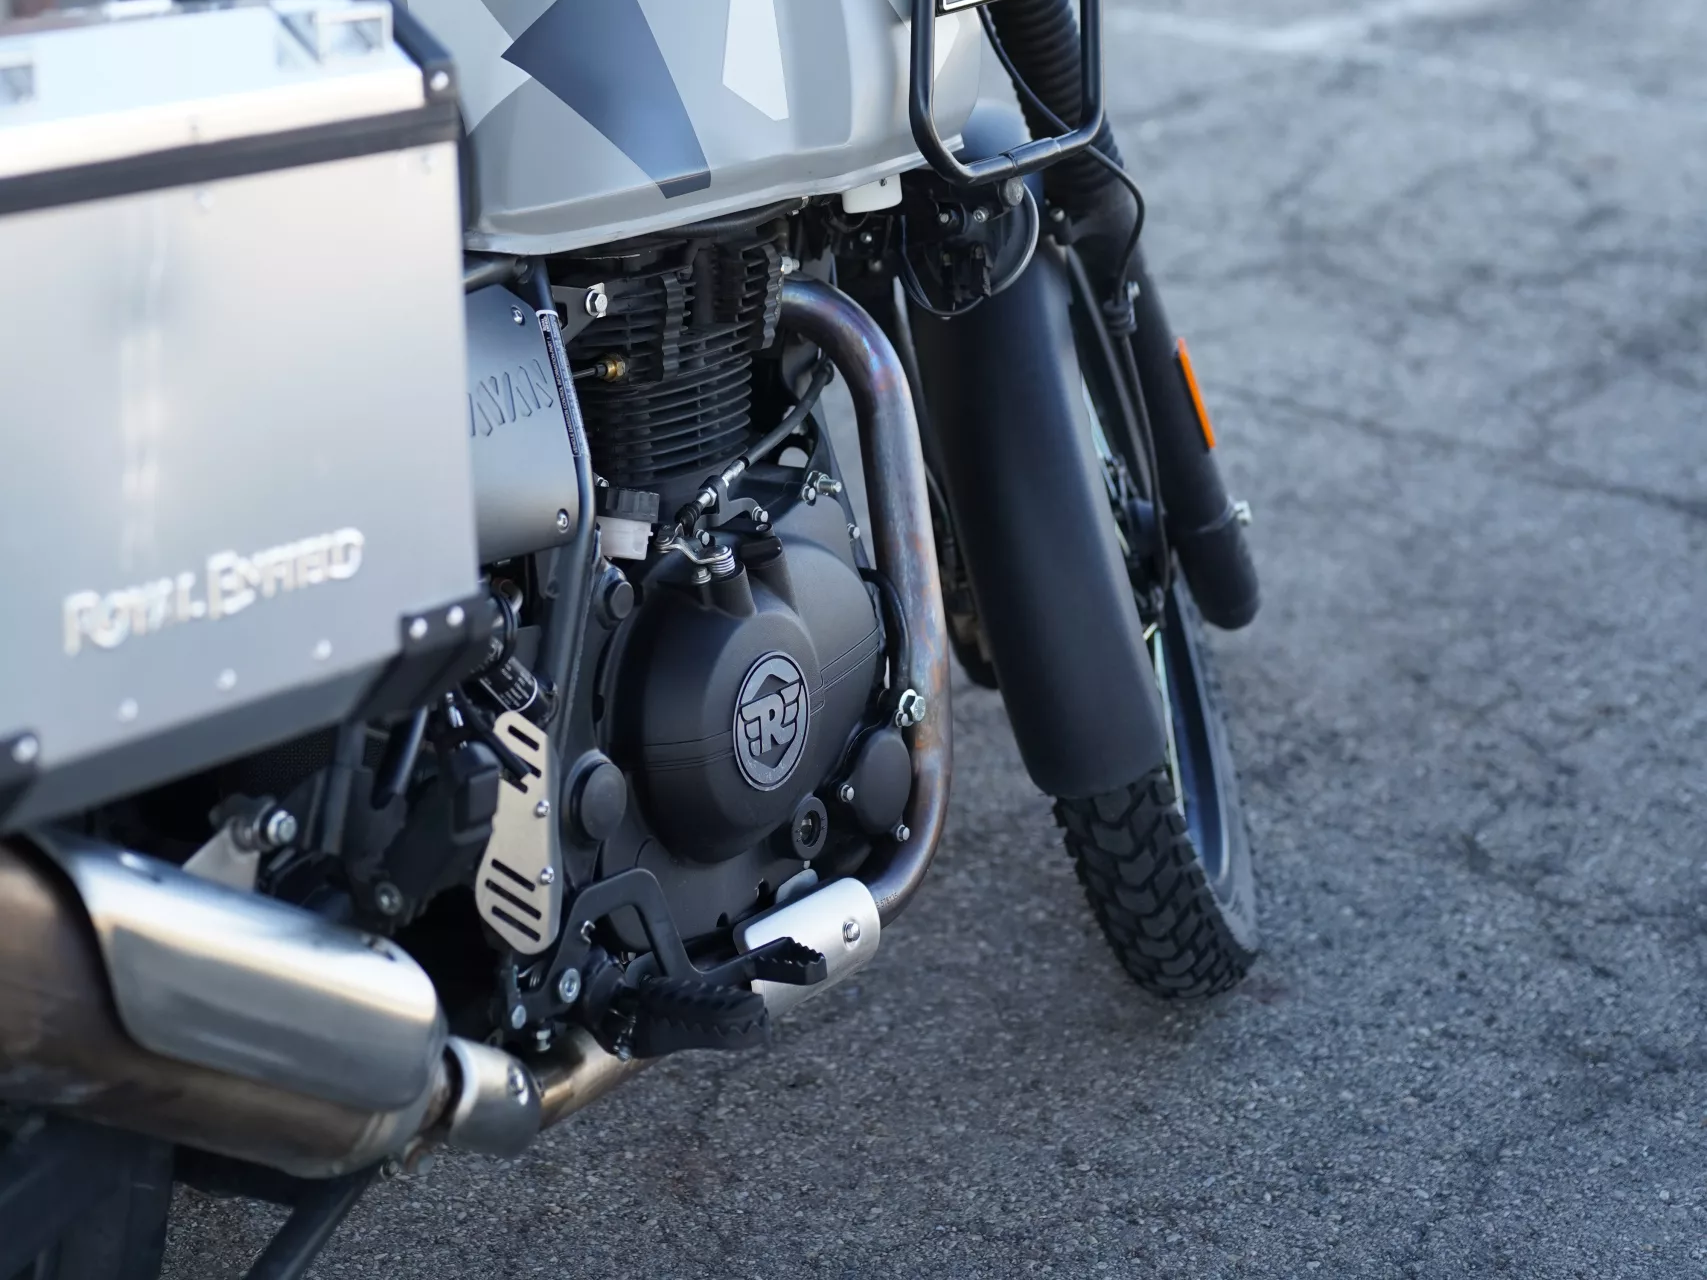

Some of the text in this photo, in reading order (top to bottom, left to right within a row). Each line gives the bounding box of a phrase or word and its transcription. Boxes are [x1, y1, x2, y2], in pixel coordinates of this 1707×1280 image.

[558, 386, 567, 409] CONTROL
[64, 526, 365, 656] ROYAL ENFIELD
